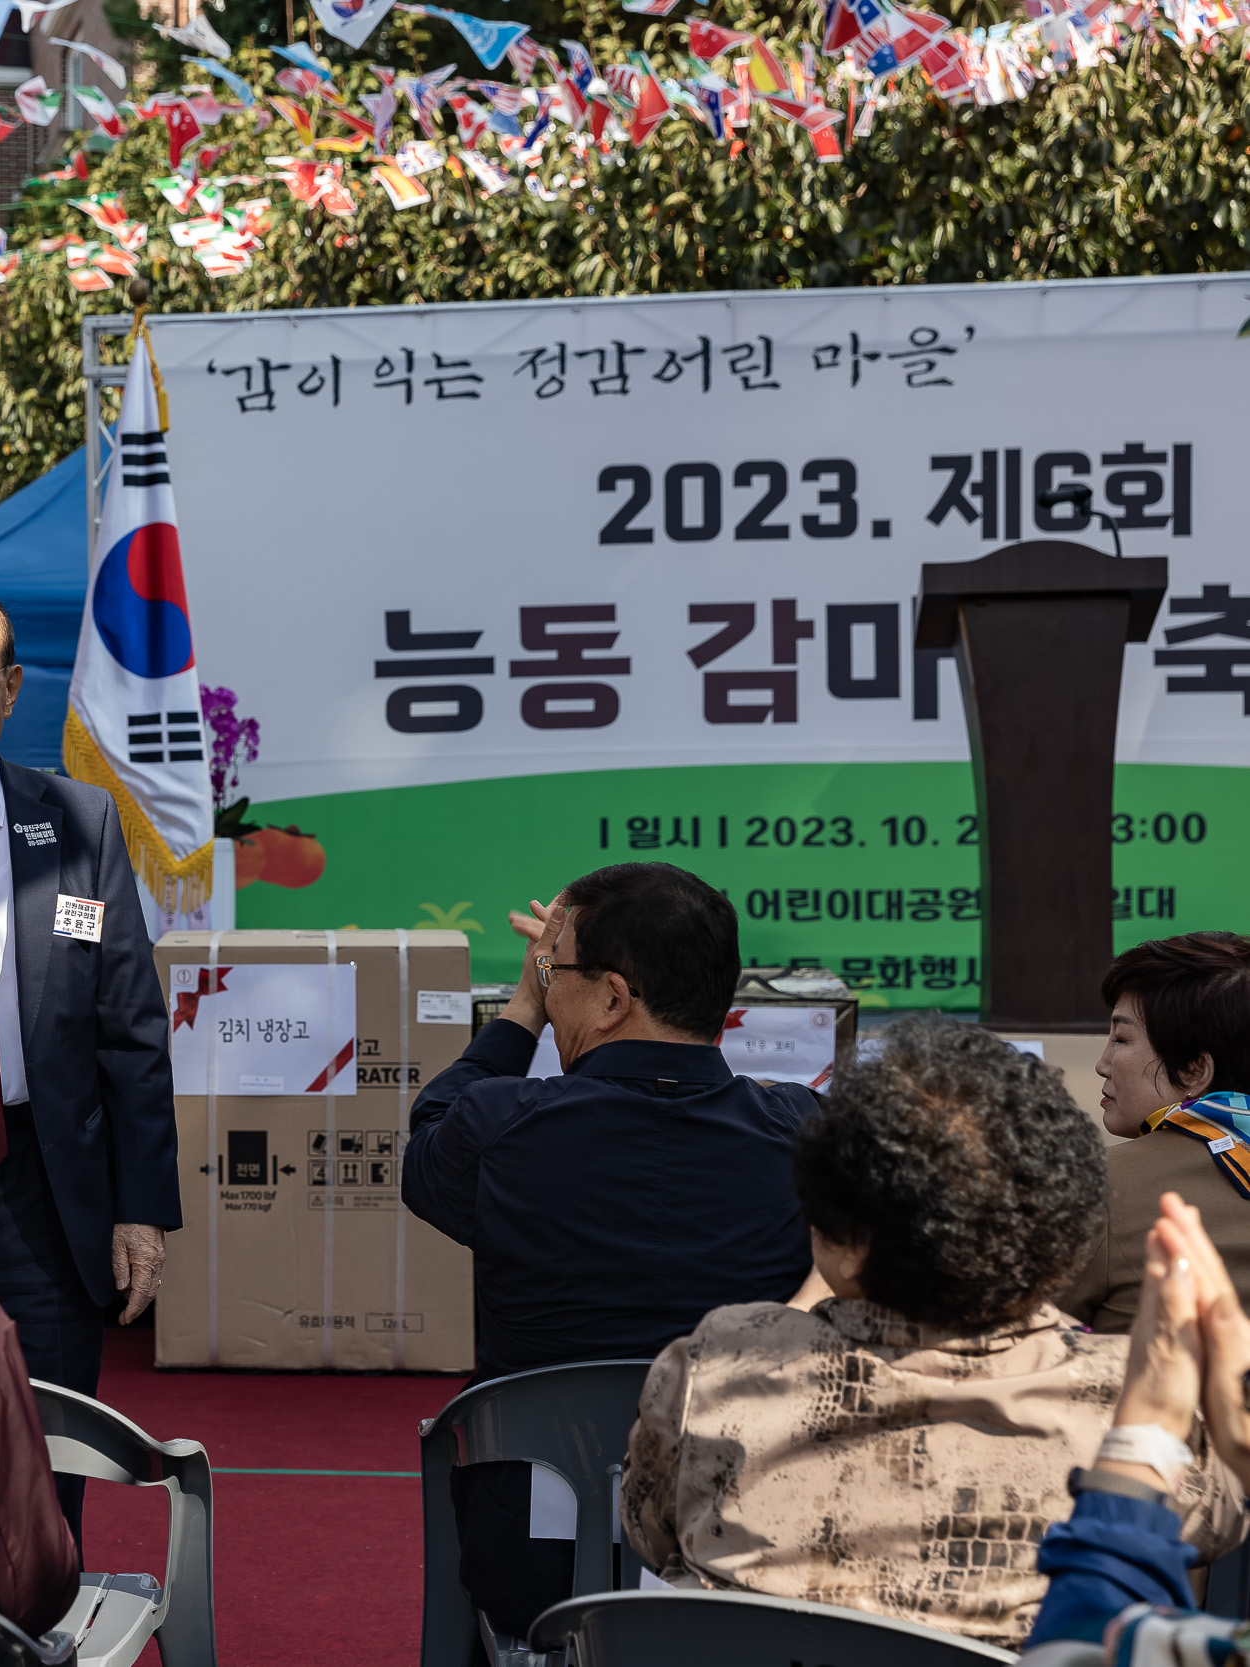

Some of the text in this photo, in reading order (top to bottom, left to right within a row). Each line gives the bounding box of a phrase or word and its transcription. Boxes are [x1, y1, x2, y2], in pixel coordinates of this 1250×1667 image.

[373, 347, 485, 405] 익는
[513, 334, 781, 400] 정감어린
[597, 442, 1193, 546] 2023. 제6회
[375, 604, 634, 733] 능동
[686, 597, 956, 726] 감마
[22, 822, 52, 833] 광진구의회
[625, 815, 702, 850] 일시
[744, 815, 867, 848] 2023.
[880, 814, 941, 848] 10.
[955, 814, 980, 847] 2
[64, 909, 96, 921] 광진구의회
[745, 887, 982, 923] 어린이대공원
[218, 1018, 310, 1044] 김치 냉장고
[236, 1163, 261, 1178] 전면
[220, 1191, 239, 1200] Max
[241, 1191, 262, 1200] 1700
[225, 1203, 243, 1211] Max
